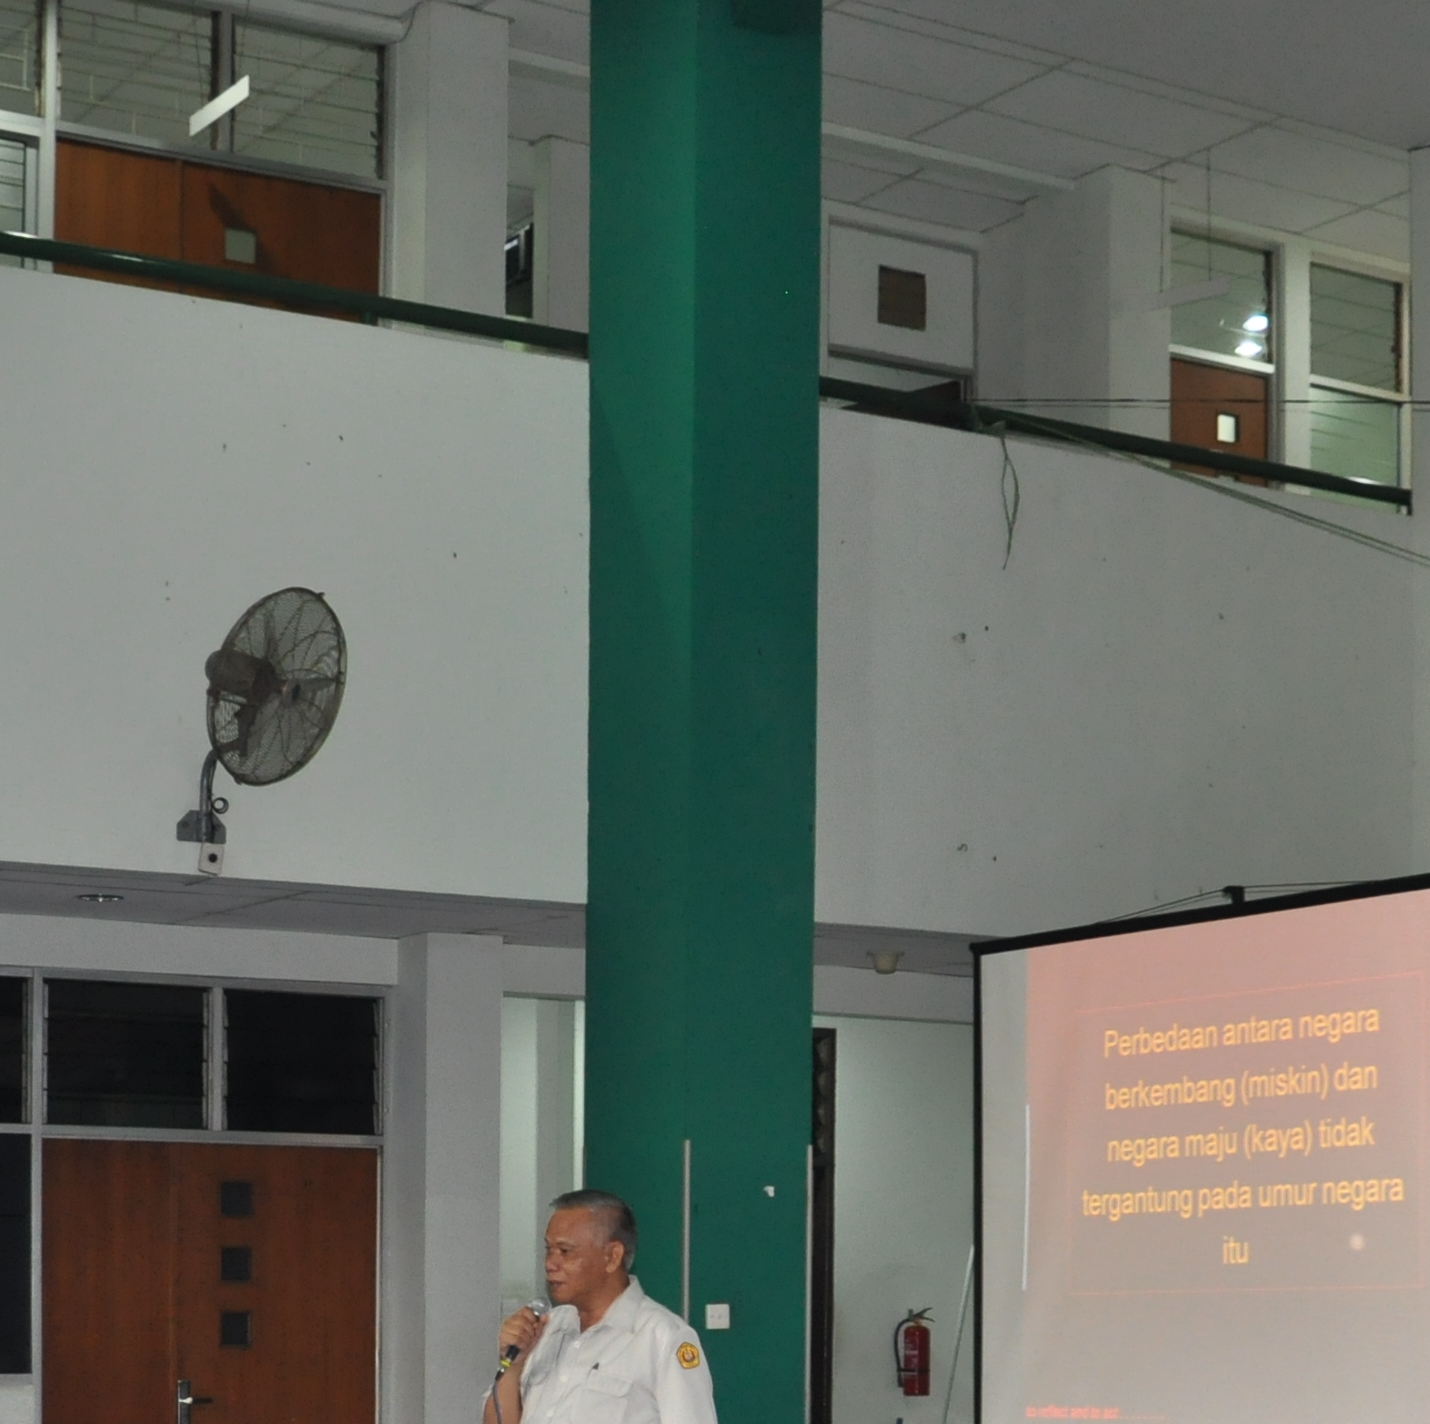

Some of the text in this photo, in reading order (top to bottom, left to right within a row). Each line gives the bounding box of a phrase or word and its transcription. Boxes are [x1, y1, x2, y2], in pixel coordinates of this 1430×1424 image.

[1104, 1008, 1380, 1057] Perbedaan antara negara
[1105, 1062, 1378, 1110] berkembang (miskin) dan
[1107, 1115, 1375, 1167] negara maju (kaya) tidak
[1082, 1177, 1404, 1221] tergantung pada umur negara
[1222, 1235, 1249, 1264] itu
